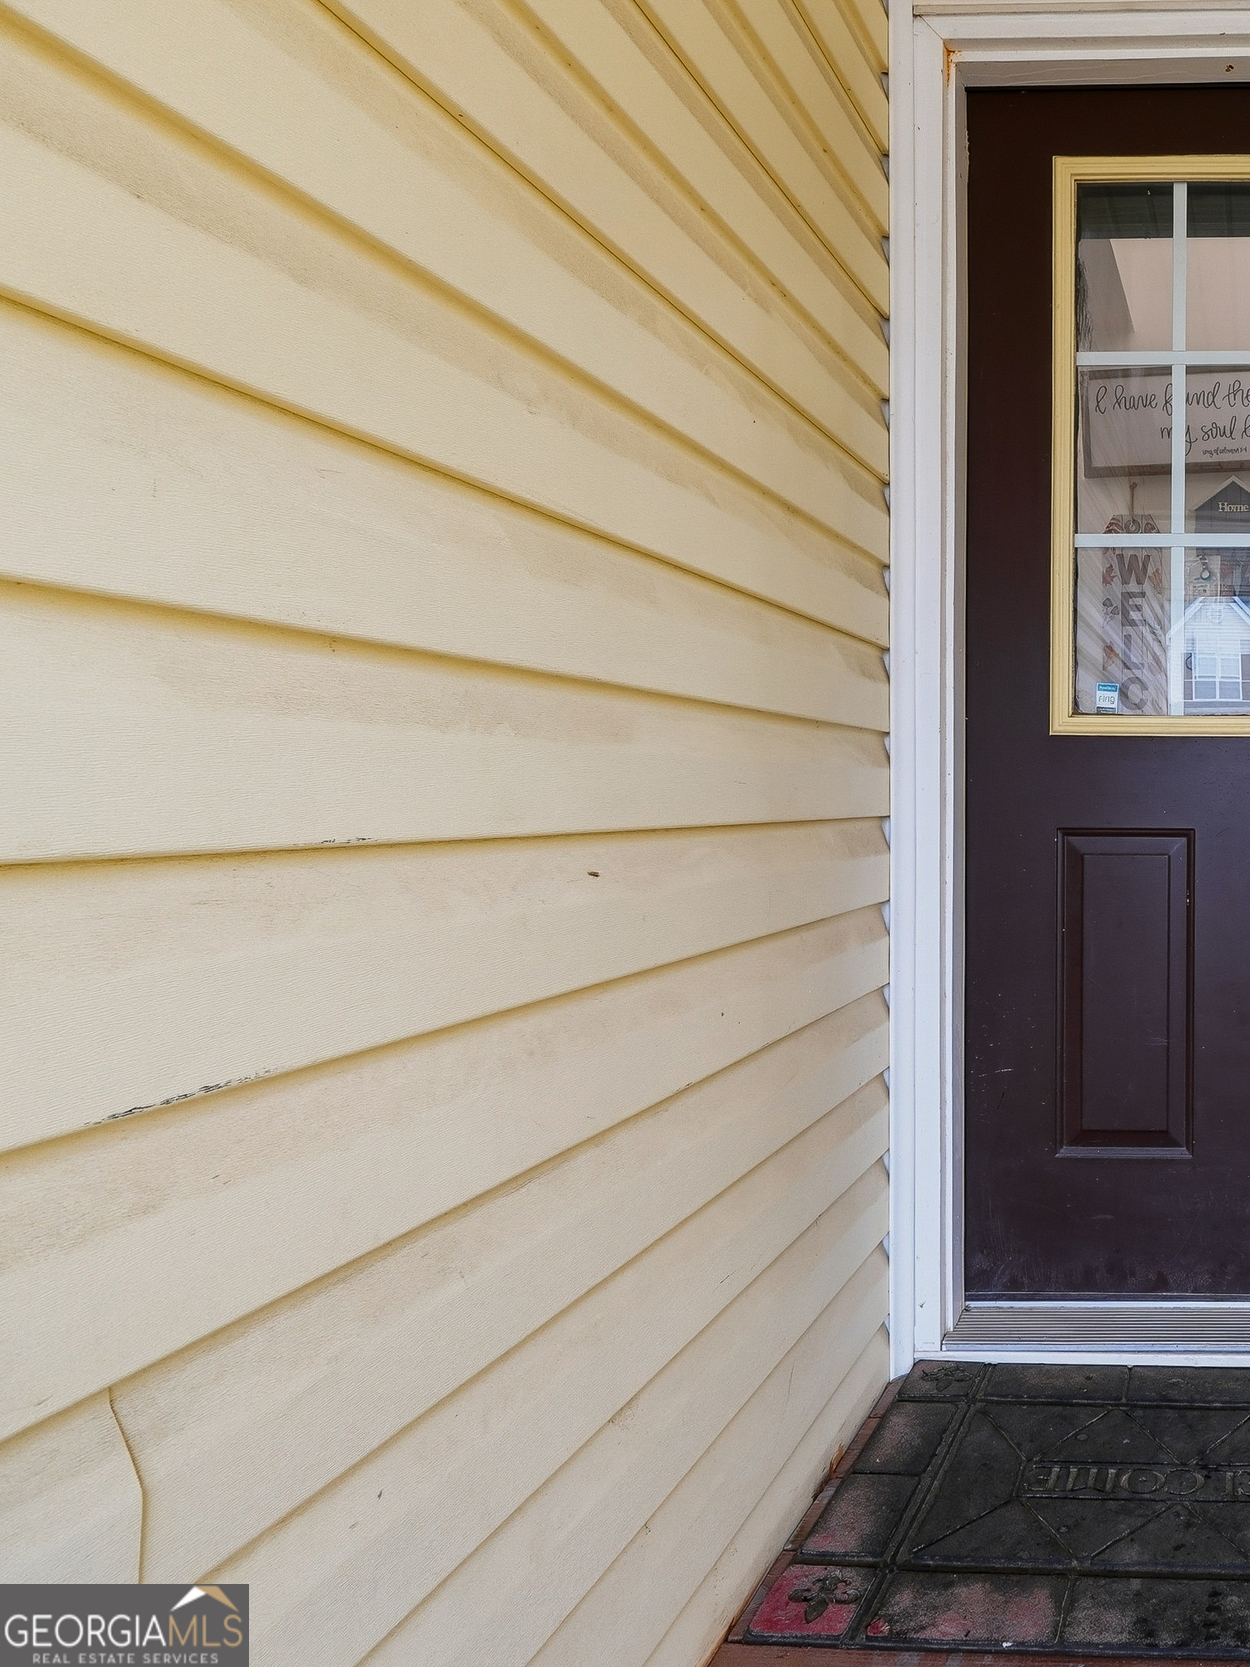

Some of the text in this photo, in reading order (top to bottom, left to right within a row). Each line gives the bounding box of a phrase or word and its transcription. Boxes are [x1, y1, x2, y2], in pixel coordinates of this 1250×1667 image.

[1112, 384, 1158, 411] have
[1162, 381, 1221, 416] fund
[1200, 415, 1236, 442] soul
[1217, 501, 1250, 512] Home
[1098, 695, 1116, 705] ring
